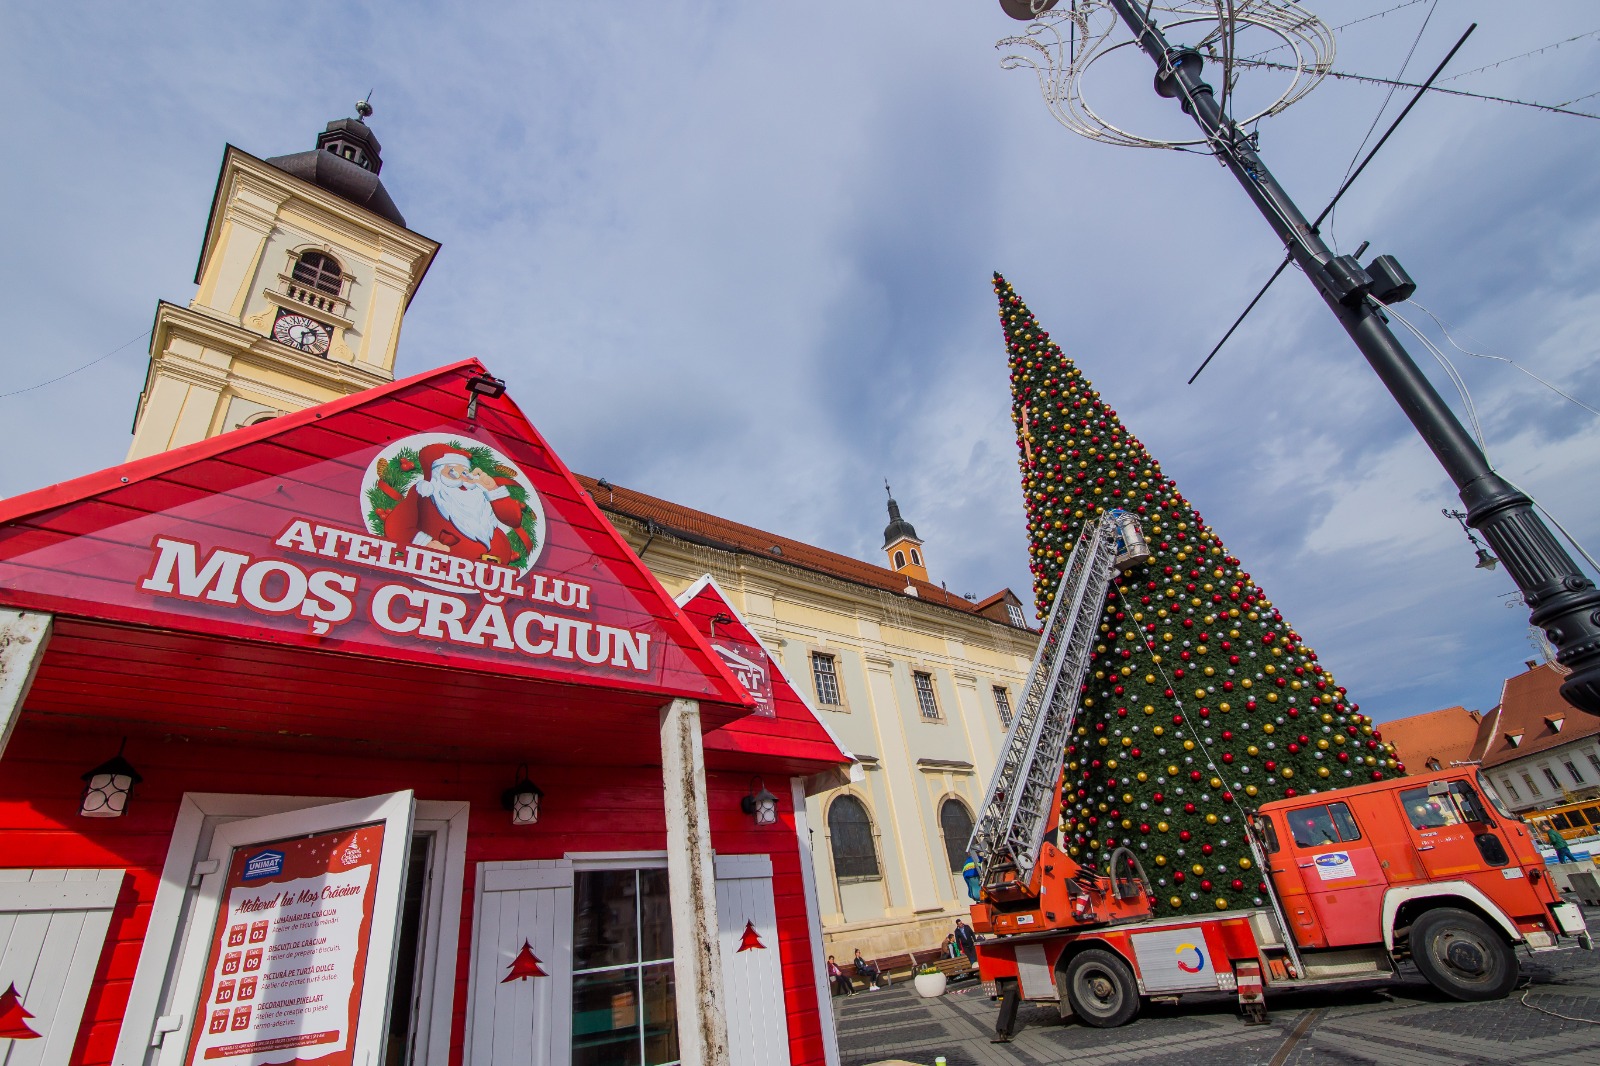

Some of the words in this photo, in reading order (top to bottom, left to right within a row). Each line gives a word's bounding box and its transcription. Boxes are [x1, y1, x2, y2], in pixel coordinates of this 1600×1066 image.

[275, 520, 525, 597] ATELIERUL
[531, 576, 590, 610] LUI
[142, 539, 359, 635] MOȘ
[371, 584, 650, 671] CRĂCIUN
[249, 859, 280, 870] UNIMAT
[235, 892, 281, 915] Atelierul
[280, 890, 295, 907] lui
[321, 883, 361, 900] Crăciun
[303, 912, 311, 920] DE
[231, 933, 243, 944] 16
[252, 930, 264, 940] 02
[292, 941, 300, 949] DE
[225, 961, 237, 972] 03
[246, 958, 259, 969] 09
[288, 969, 296, 977] PE
[315, 963, 335, 973] DULCE
[219, 989, 231, 1001] 10
[241, 986, 253, 997] 16
[275, 1010, 283, 1018] de
[304, 1006, 312, 1014] cu
[212, 1019, 225, 1030] 17
[235, 1016, 247, 1027] 23
